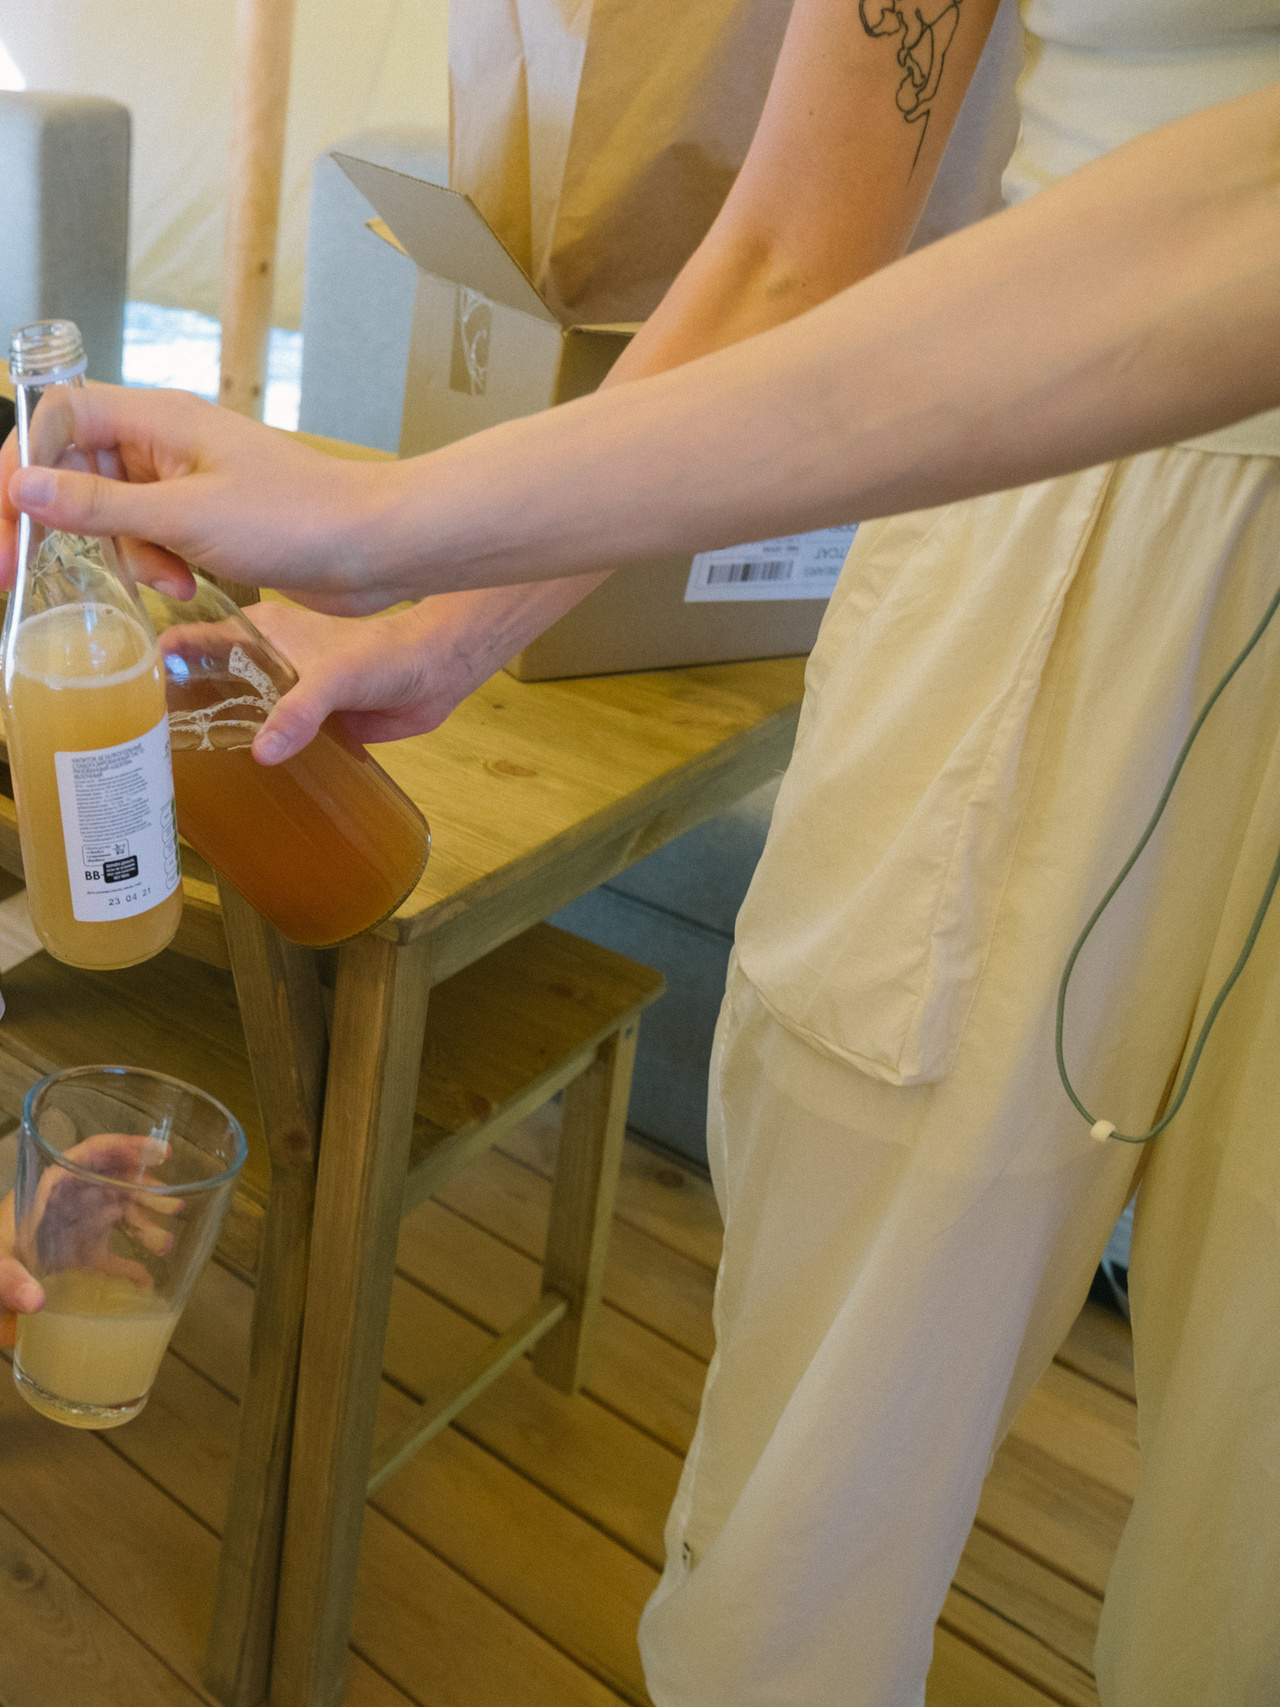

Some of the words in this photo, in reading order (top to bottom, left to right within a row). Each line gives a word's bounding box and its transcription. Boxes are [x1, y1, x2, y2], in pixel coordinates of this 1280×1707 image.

[109, 897, 121, 906] 23
[125, 893, 137, 903] 04
[142, 887, 151, 897] 21
